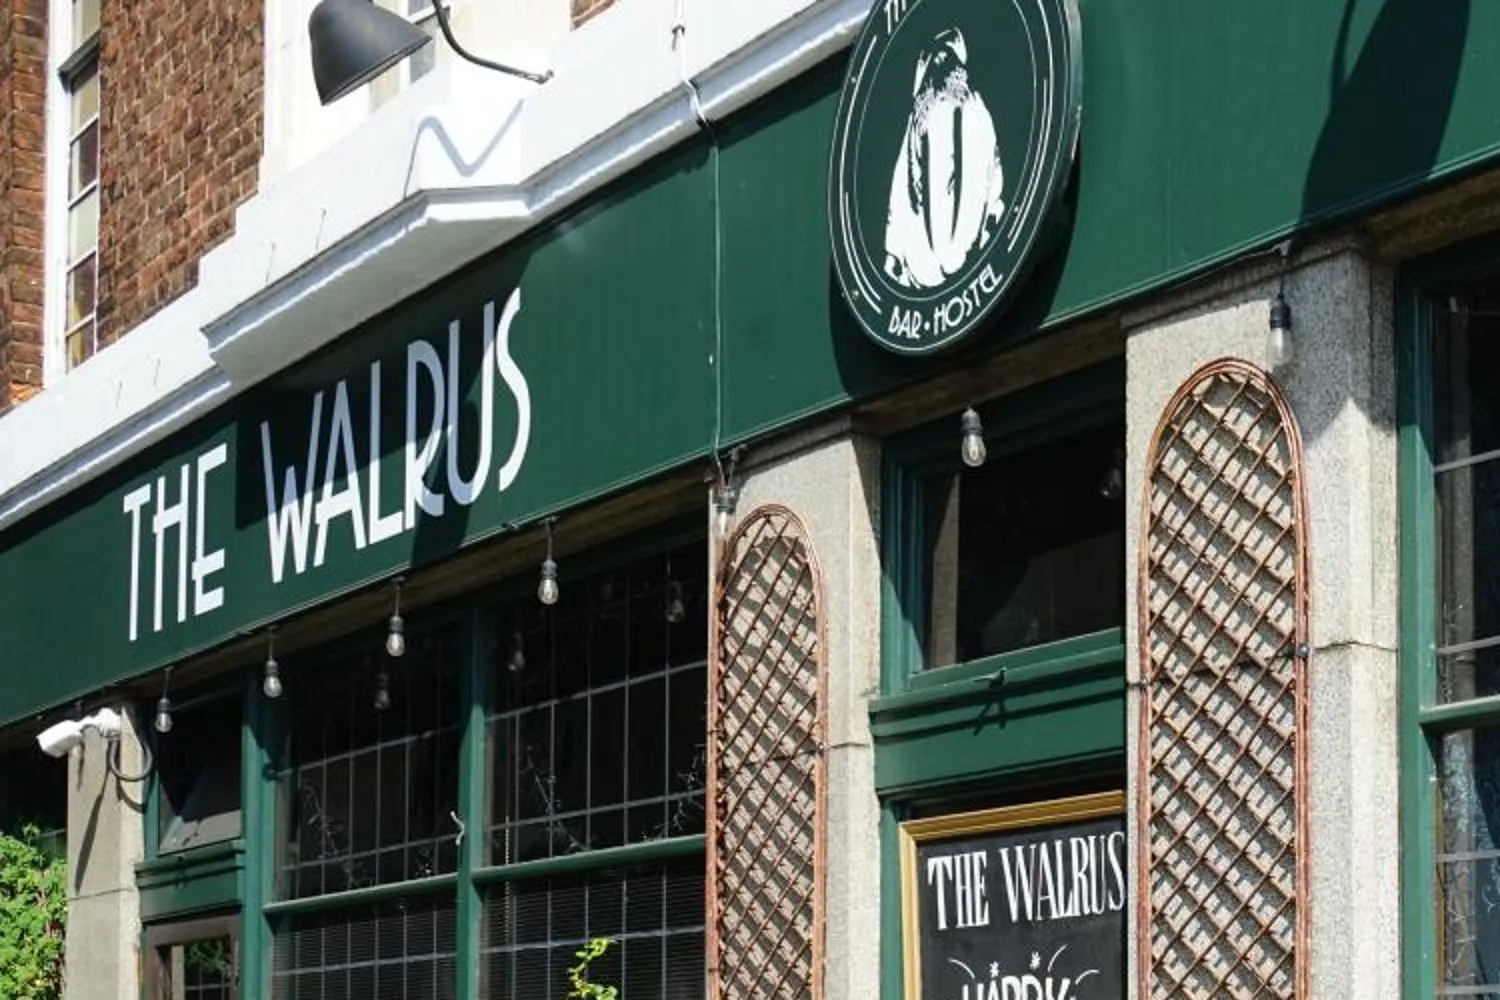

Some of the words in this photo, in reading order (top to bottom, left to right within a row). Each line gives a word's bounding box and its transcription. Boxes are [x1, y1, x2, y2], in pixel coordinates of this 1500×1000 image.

[888, 306, 921, 339] BAR
[933, 264, 1002, 335] HOSTEL
[123, 442, 228, 641] THE
[260, 287, 531, 583] WALRUS
[927, 850, 990, 930] THE
[999, 831, 1126, 923] WALRUS
